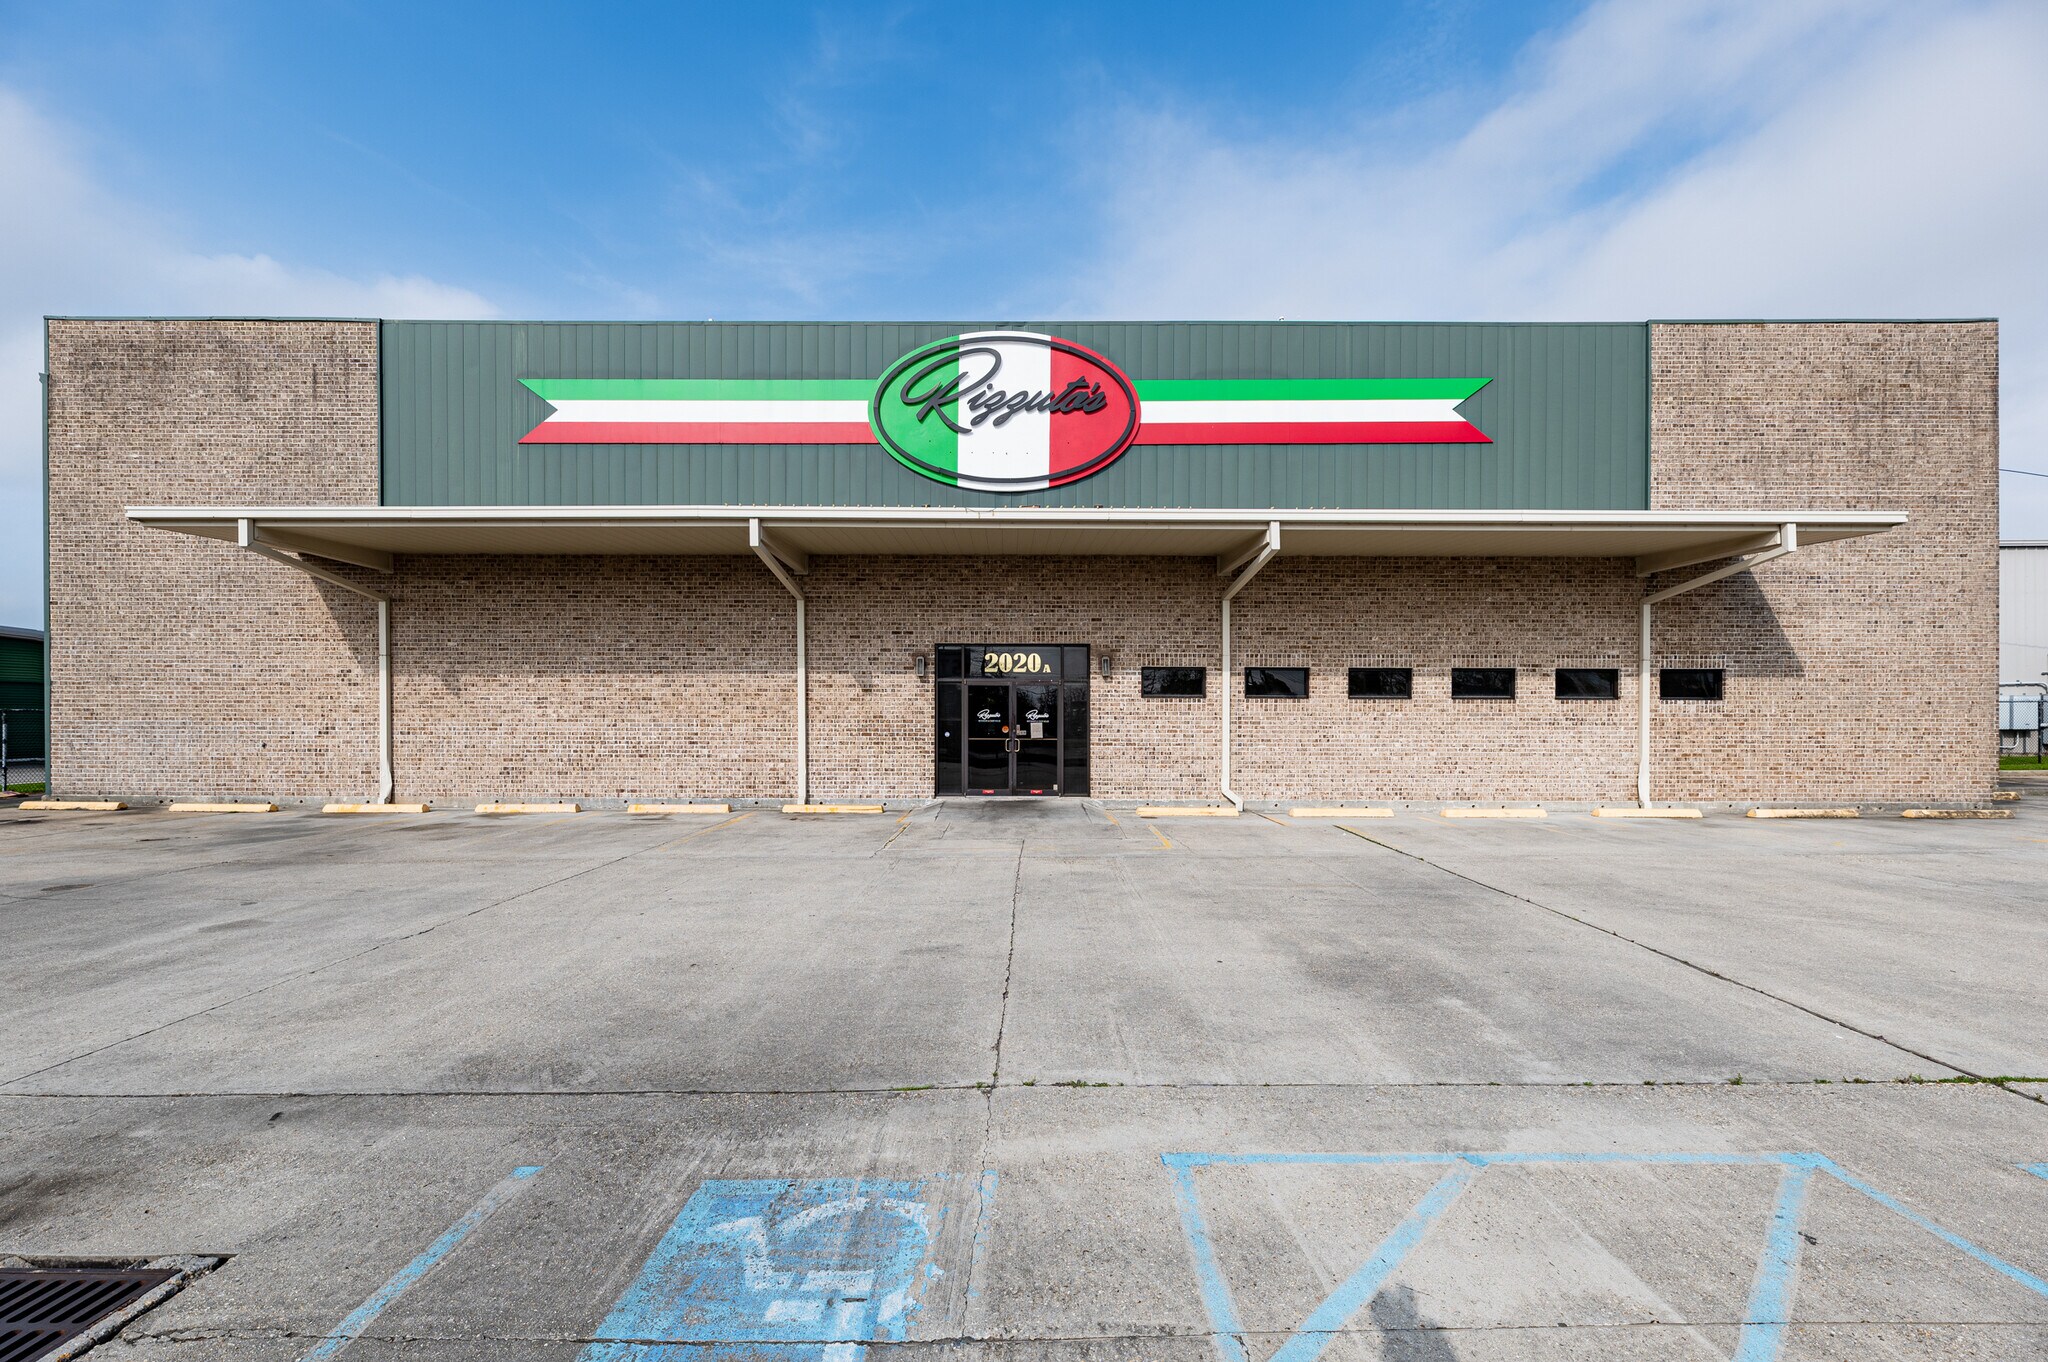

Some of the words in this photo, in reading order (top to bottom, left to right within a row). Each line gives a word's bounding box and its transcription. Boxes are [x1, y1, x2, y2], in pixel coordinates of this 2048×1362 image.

[901, 347, 1107, 433] Rizzuto's
[984, 653, 1041, 672] 2020
[1043, 664, 1051, 672] A
